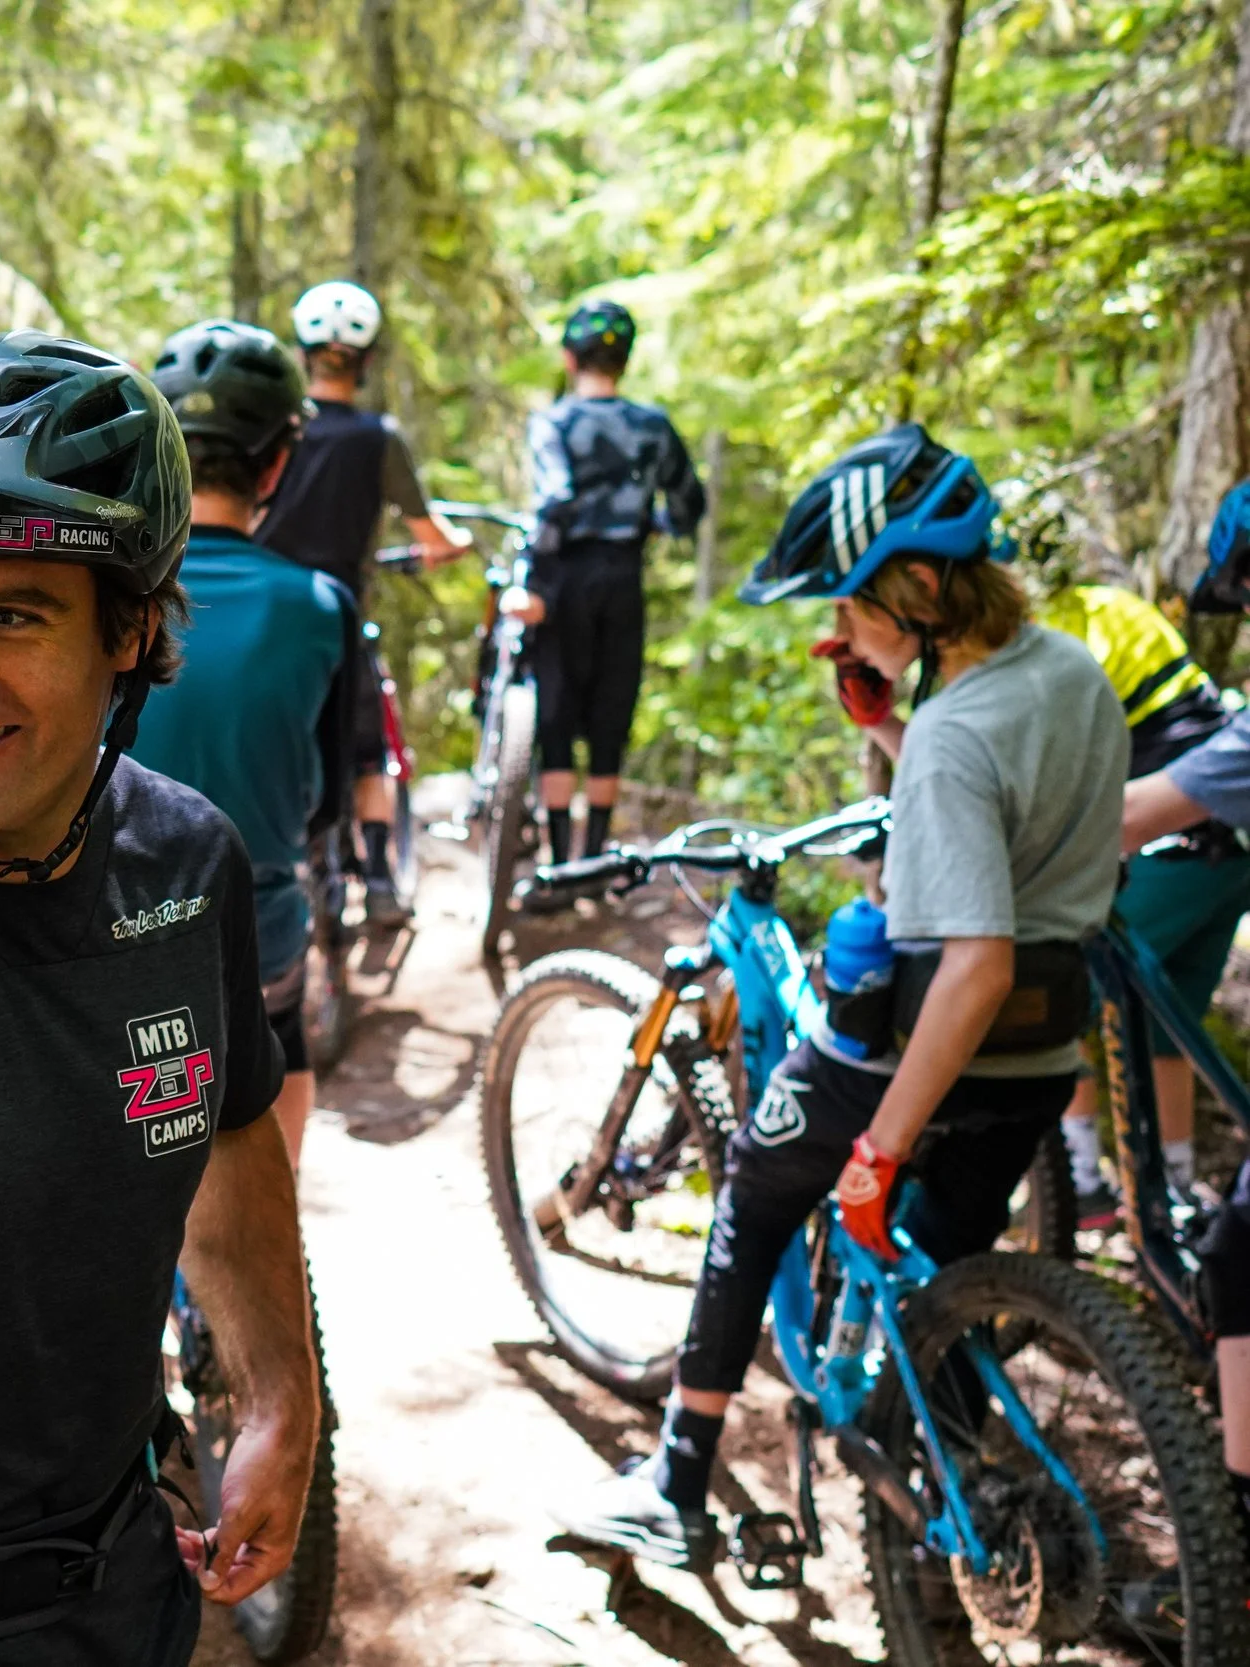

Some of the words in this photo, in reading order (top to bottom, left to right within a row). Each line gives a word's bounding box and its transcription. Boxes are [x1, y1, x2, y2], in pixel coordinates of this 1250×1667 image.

[60, 528, 109, 546] RACING
[137, 1018, 188, 1057] MTB
[117, 1049, 214, 1123] ZEP
[150, 1111, 206, 1145] CAMPS
